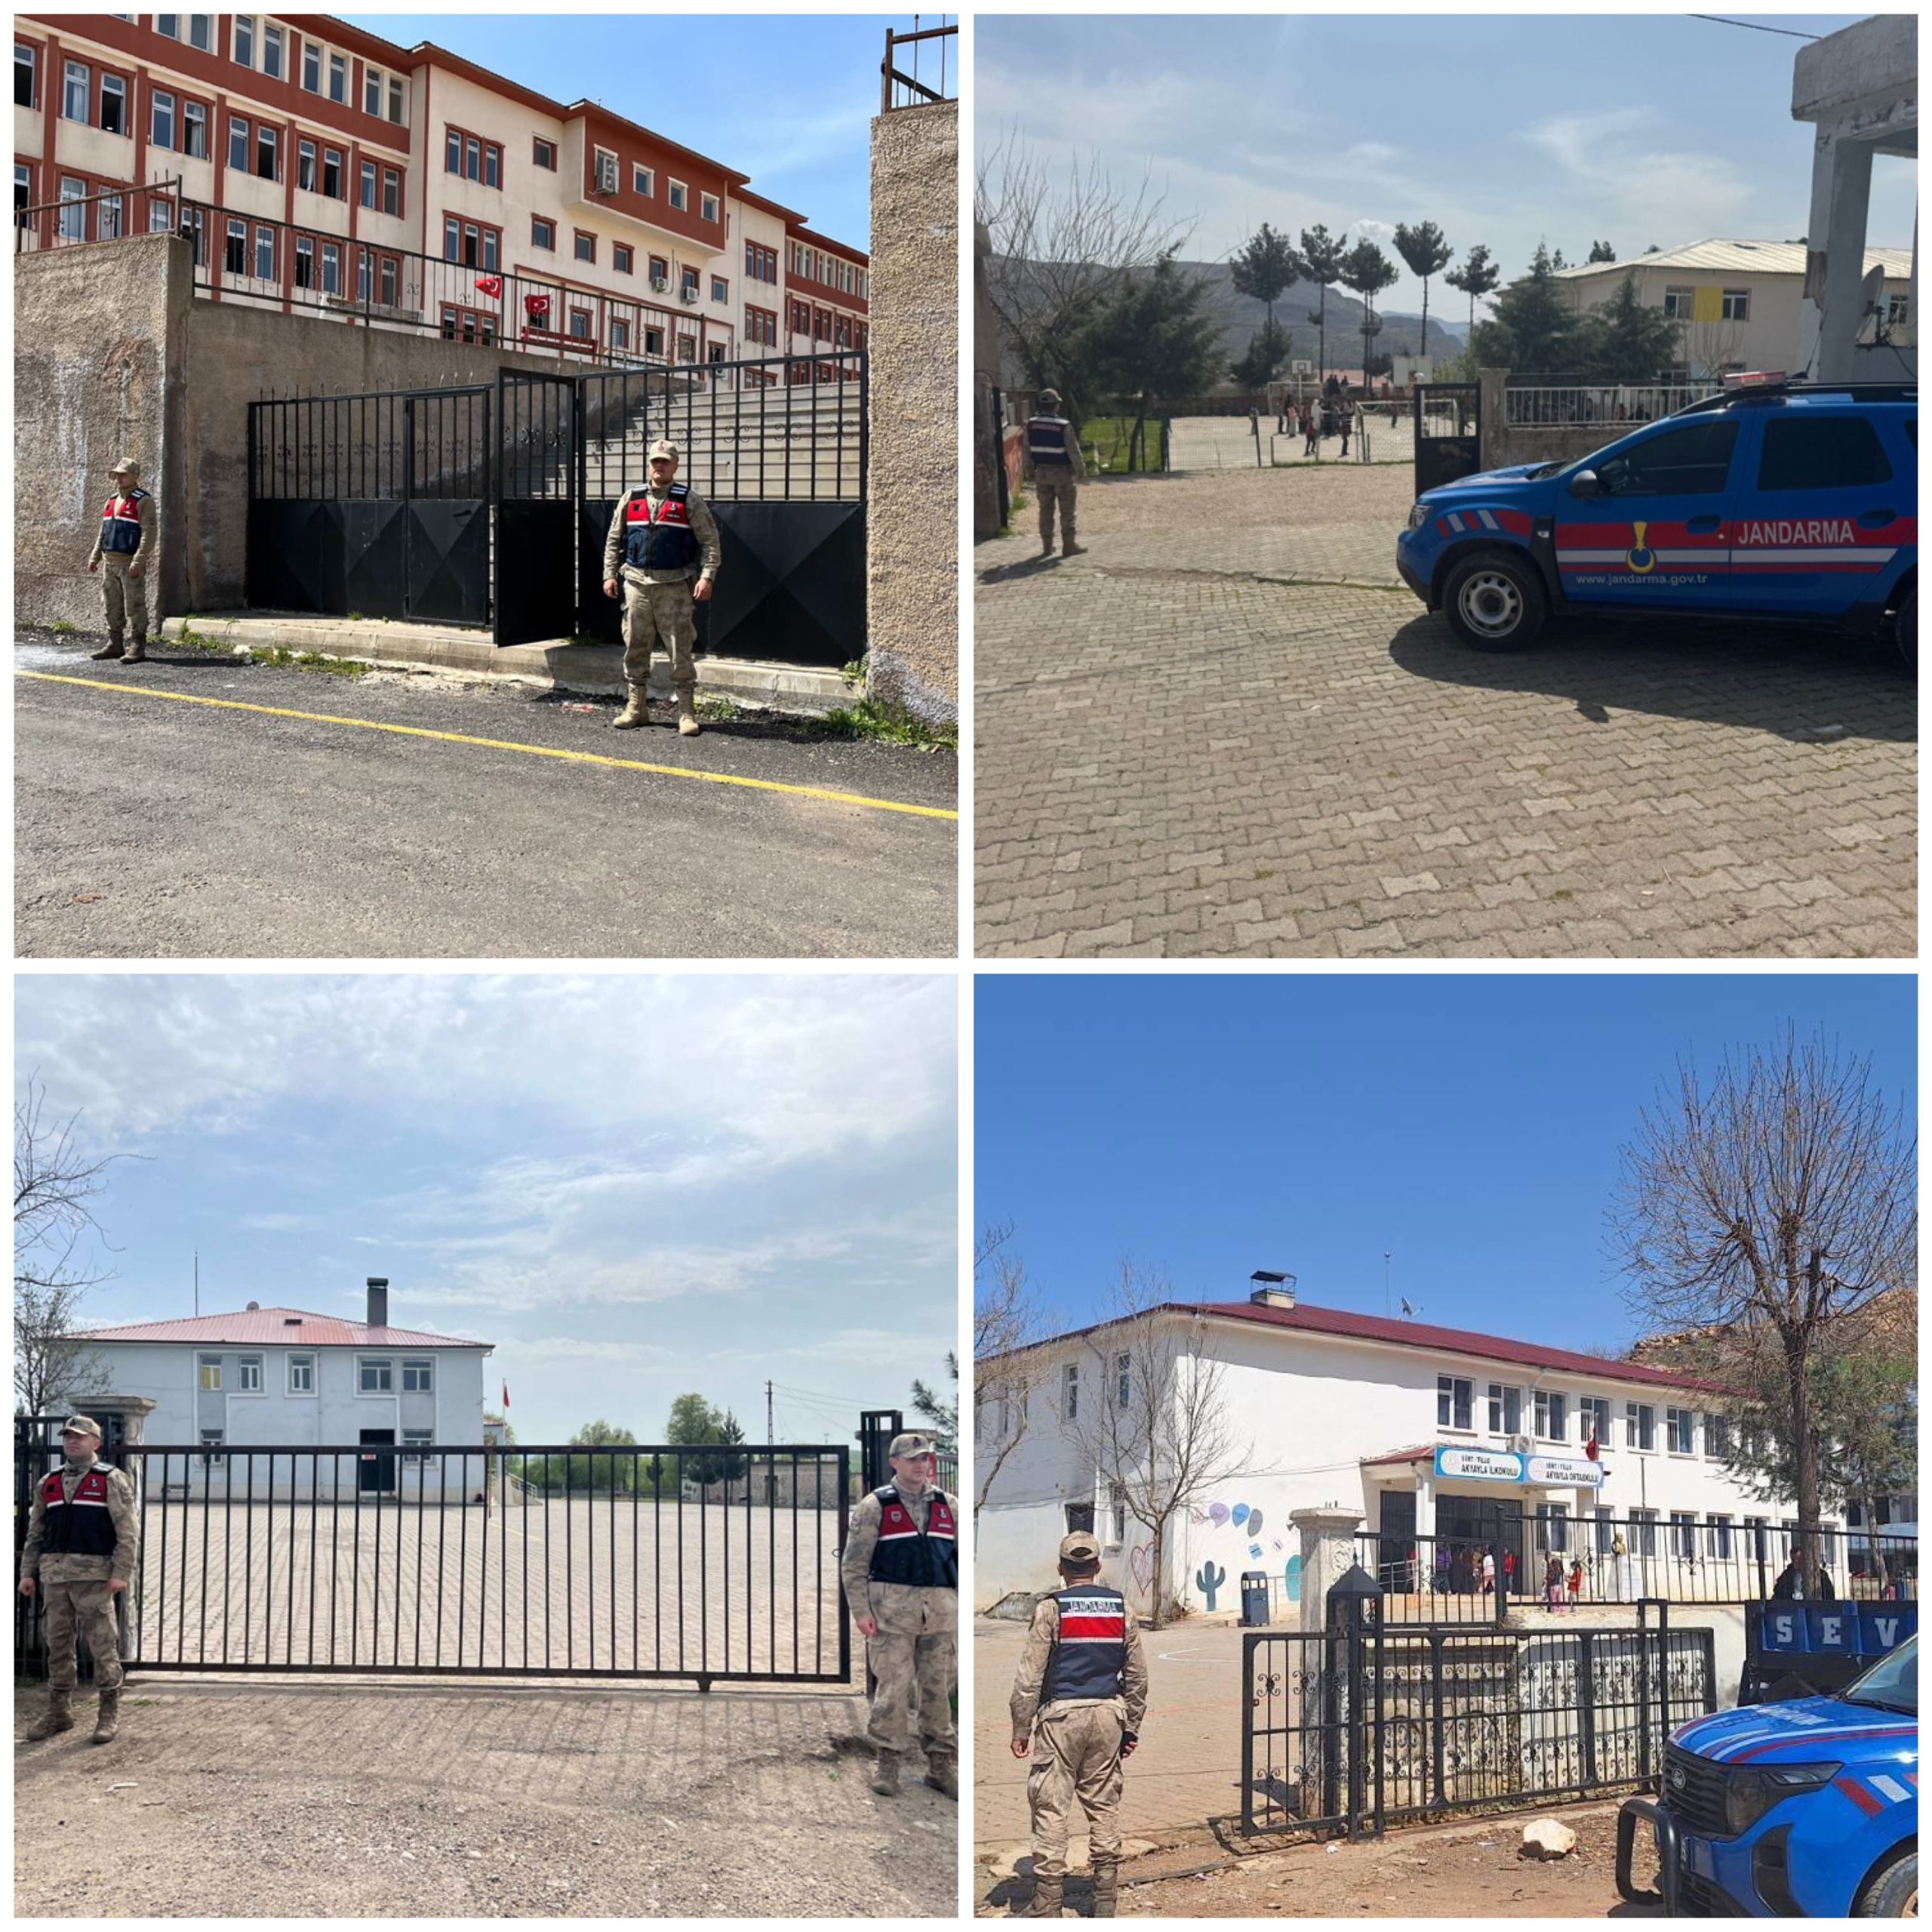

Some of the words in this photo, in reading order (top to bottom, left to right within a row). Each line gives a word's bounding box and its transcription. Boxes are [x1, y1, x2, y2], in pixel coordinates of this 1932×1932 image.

[1738, 521, 1855, 544] JANDARMA
[1577, 574, 1708, 586] www.jandarma.gov.tr
[1068, 1601, 1117, 1613] JANDARMA
